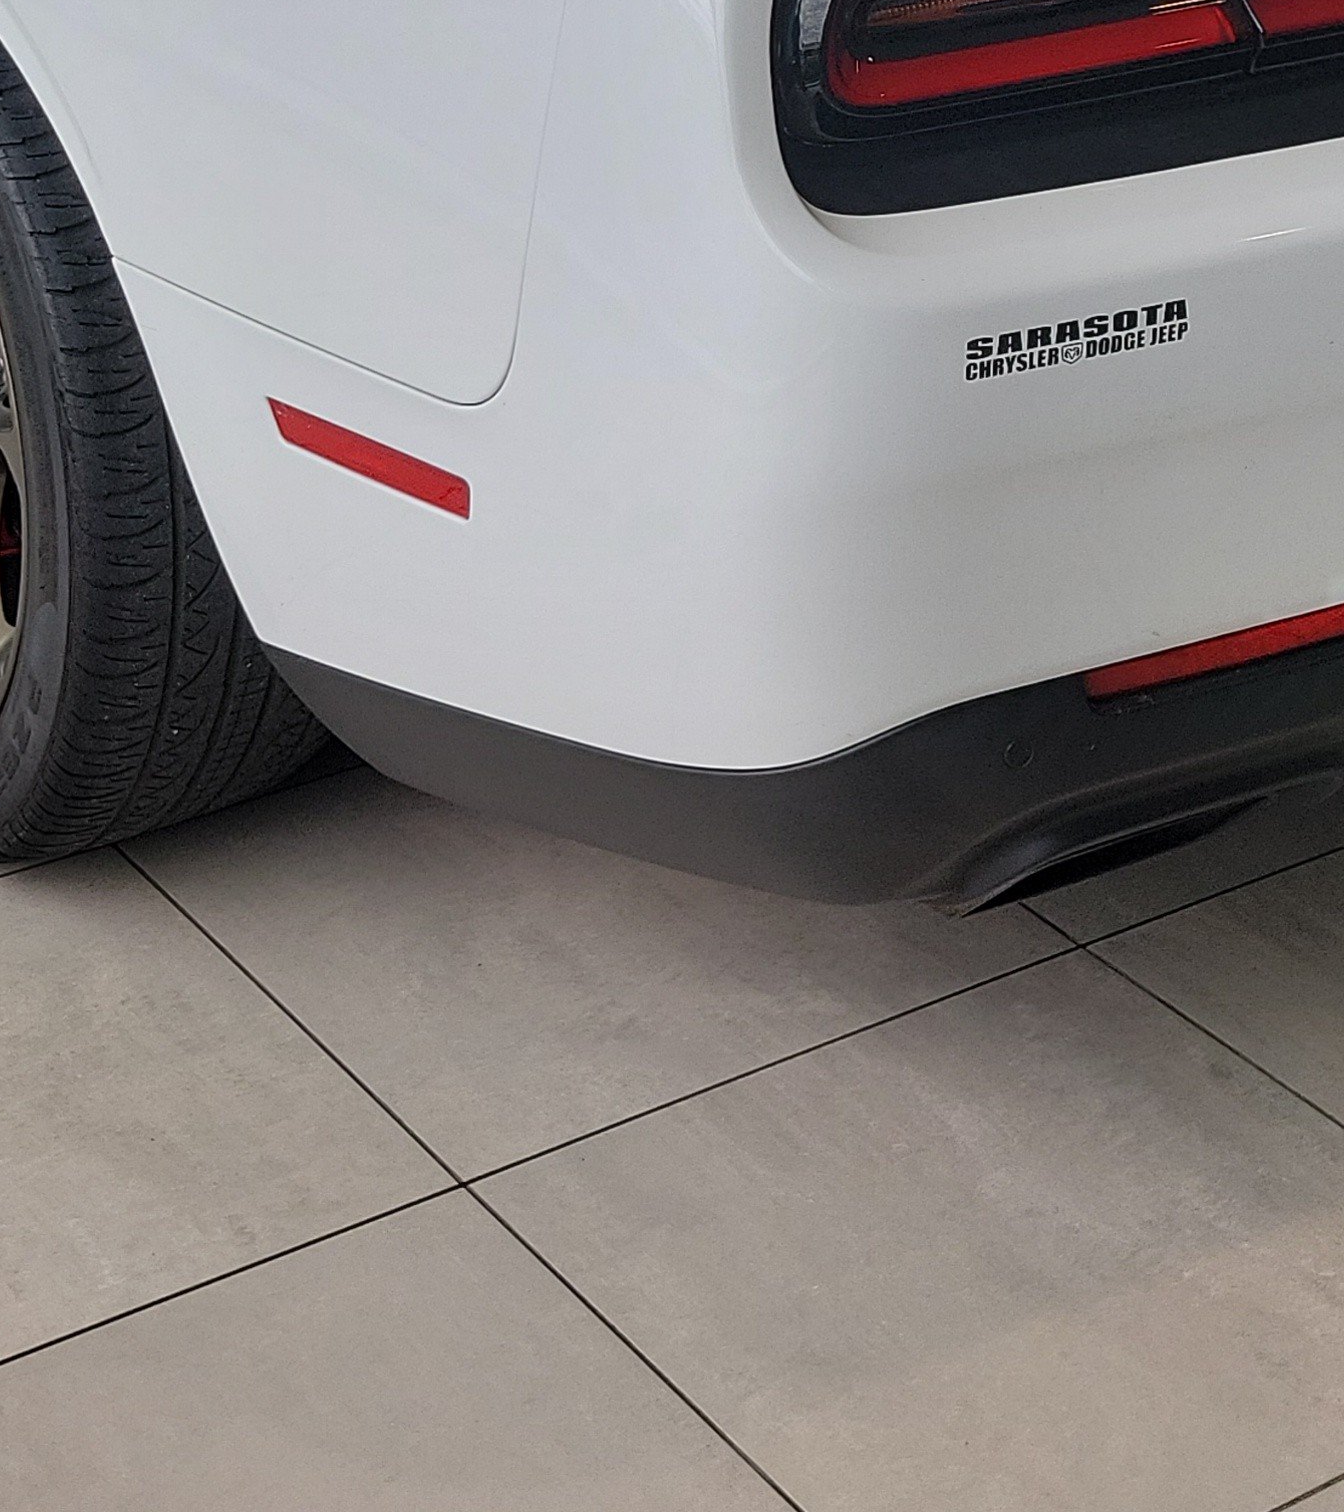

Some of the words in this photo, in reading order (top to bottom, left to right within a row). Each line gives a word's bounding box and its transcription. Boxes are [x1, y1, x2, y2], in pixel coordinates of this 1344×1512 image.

[965, 298, 1188, 360] SARASOTA
[965, 346, 1059, 381] CHRYSLER
[1085, 329, 1146, 359] DODGE
[1149, 321, 1189, 346] JEEP
